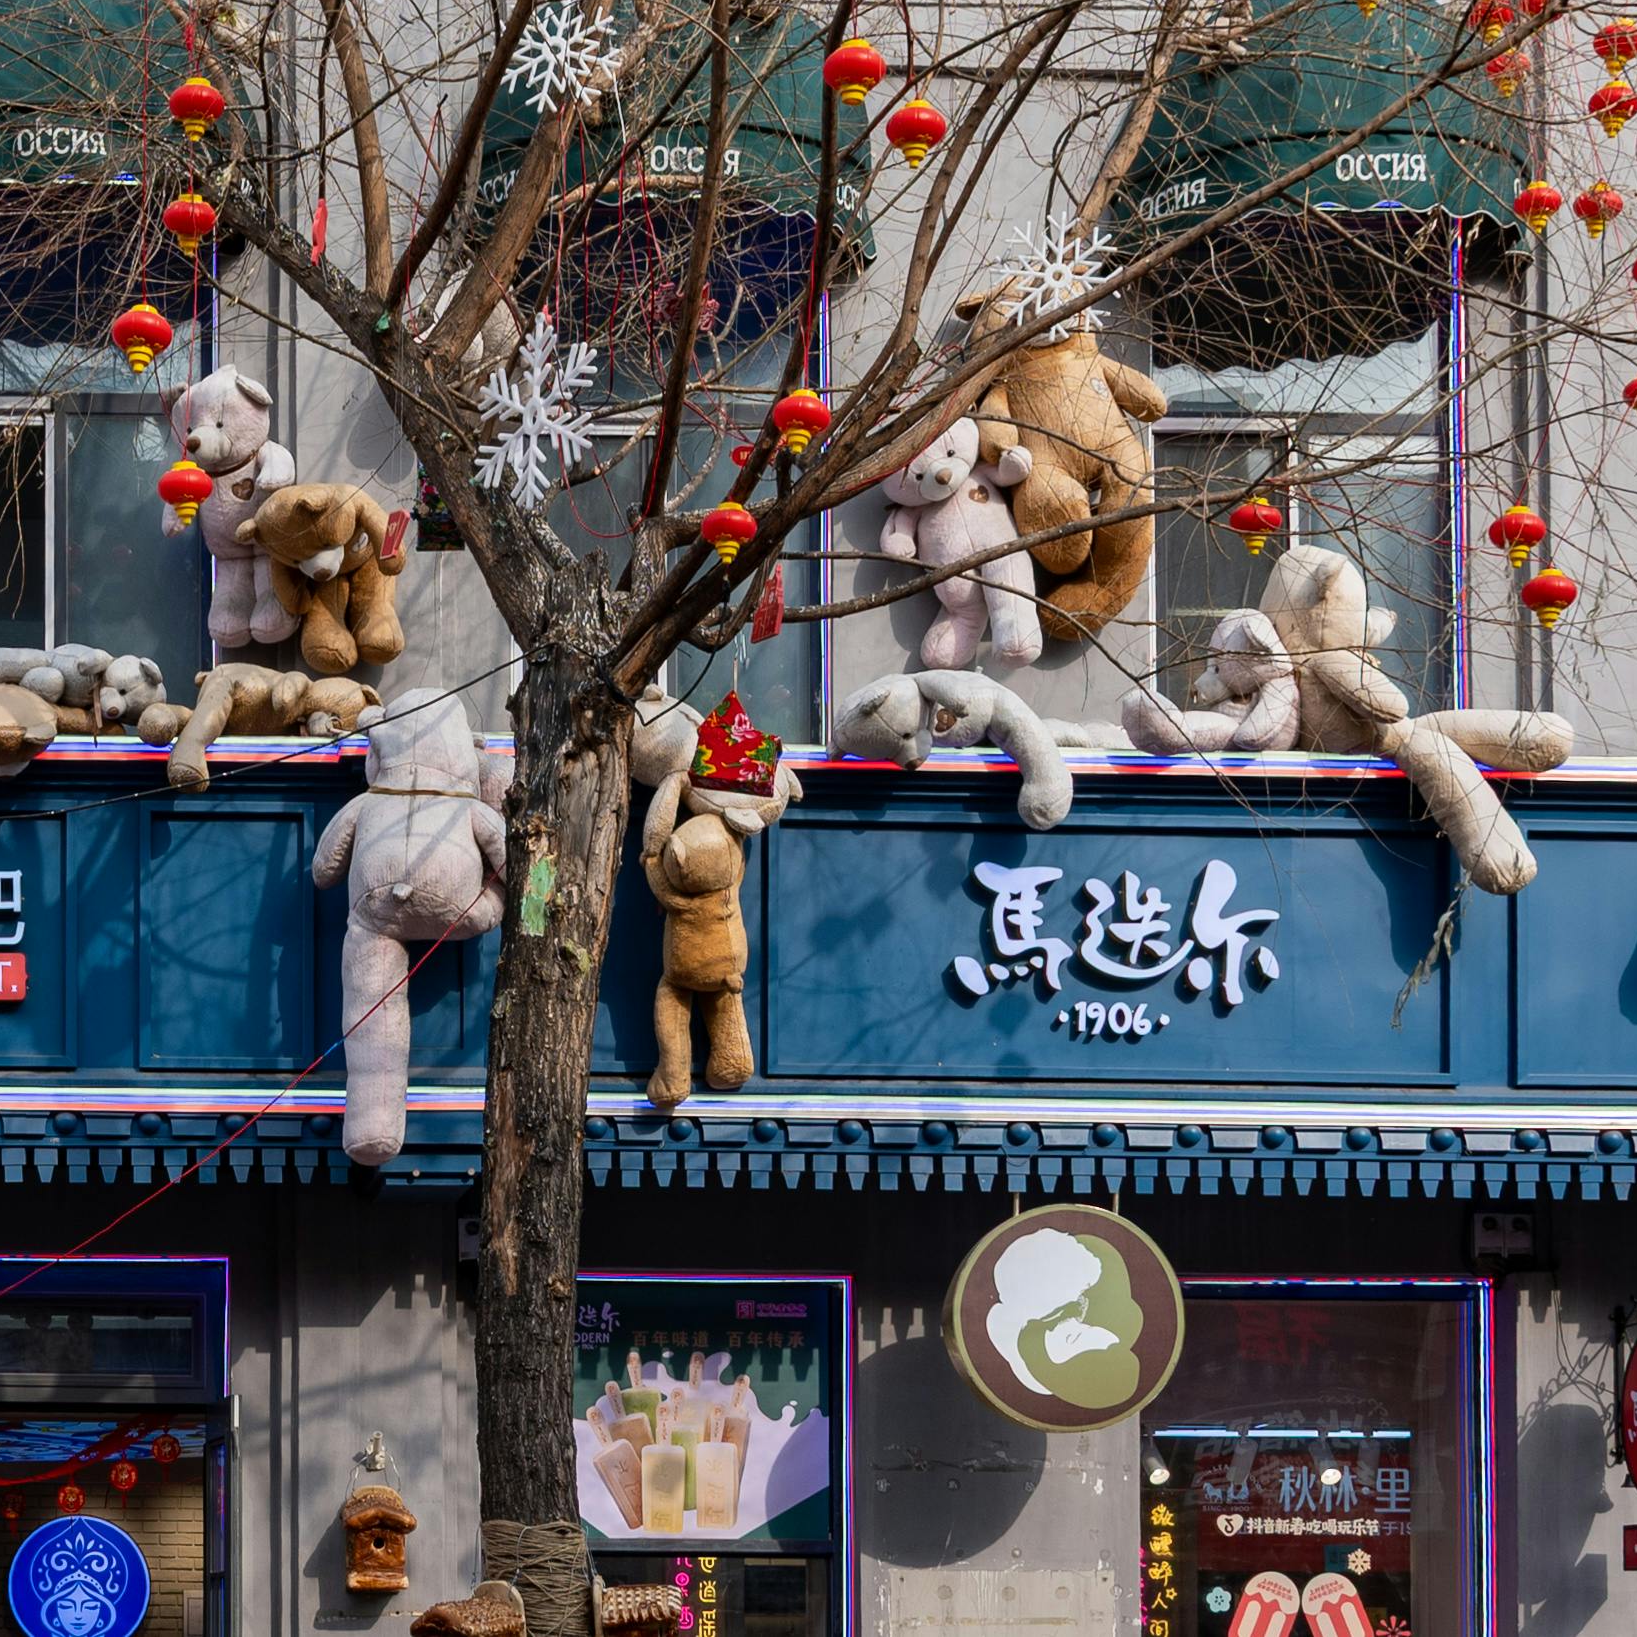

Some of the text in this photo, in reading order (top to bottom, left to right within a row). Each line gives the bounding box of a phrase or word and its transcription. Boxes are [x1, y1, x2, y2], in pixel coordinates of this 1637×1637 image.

[650, 145, 741, 176] ОССЯ
[1246, 1517, 1380, 1536] 抖音新春吃喝玩乐节
